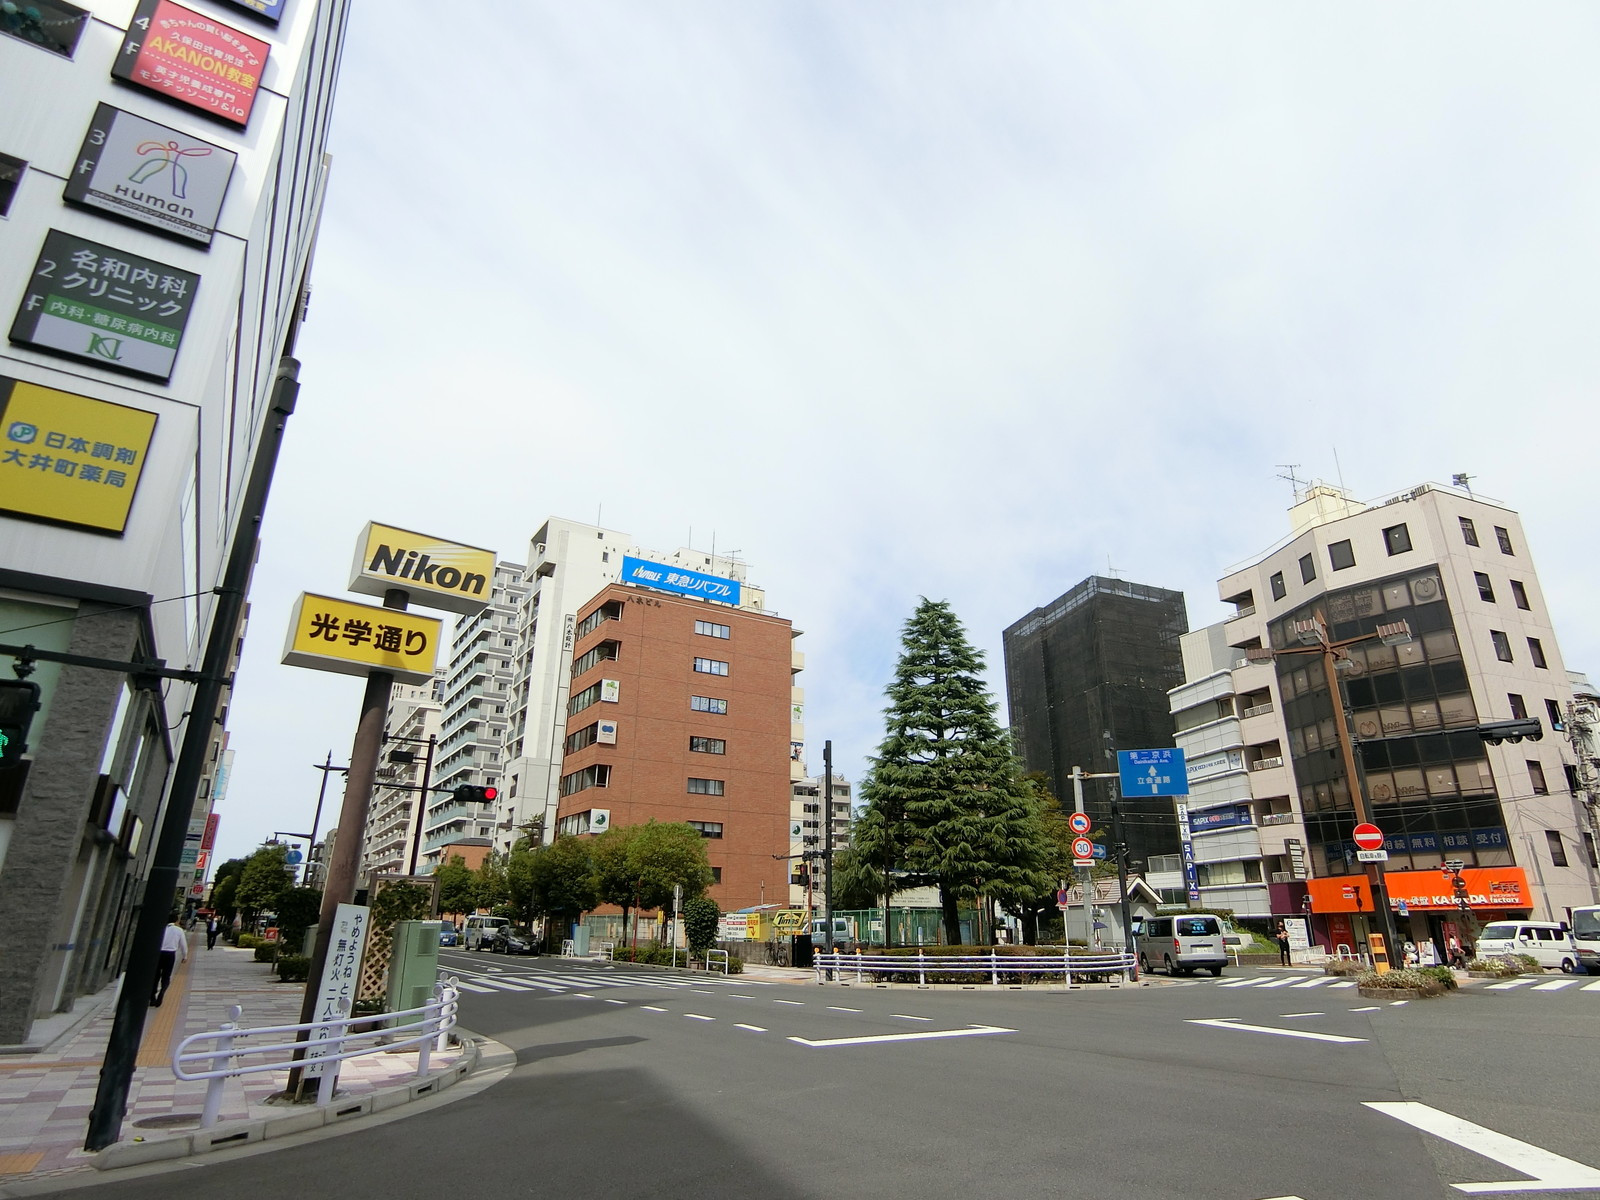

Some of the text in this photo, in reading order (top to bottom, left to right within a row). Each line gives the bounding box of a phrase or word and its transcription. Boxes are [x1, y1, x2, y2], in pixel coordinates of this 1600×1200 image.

[149, 36, 257, 90] AKANON教室
[62, 271, 183, 317] クリニック
[71, 249, 188, 299] 名和内科
[50, 300, 176, 345] 内科・糖尿病内科
[2, 448, 127, 488] 大井町薬局
[45, 431, 137, 465] 日本調剤
[368, 543, 487, 595] Nikon
[664, 572, 732, 597] 東急リバブル
[309, 613, 427, 656] 光学通り
[1129, 750, 1172, 760] 第二京浜
[1137, 775, 1171, 784] 立会道路
[1077, 843, 1088, 853] 30
[1412, 837, 1436, 848] 無料
[1443, 835, 1469, 847] 相談
[1476, 832, 1501, 844] 受付
[1184, 844, 1197, 890] SAPIX
[778, 916, 799, 925] Times
